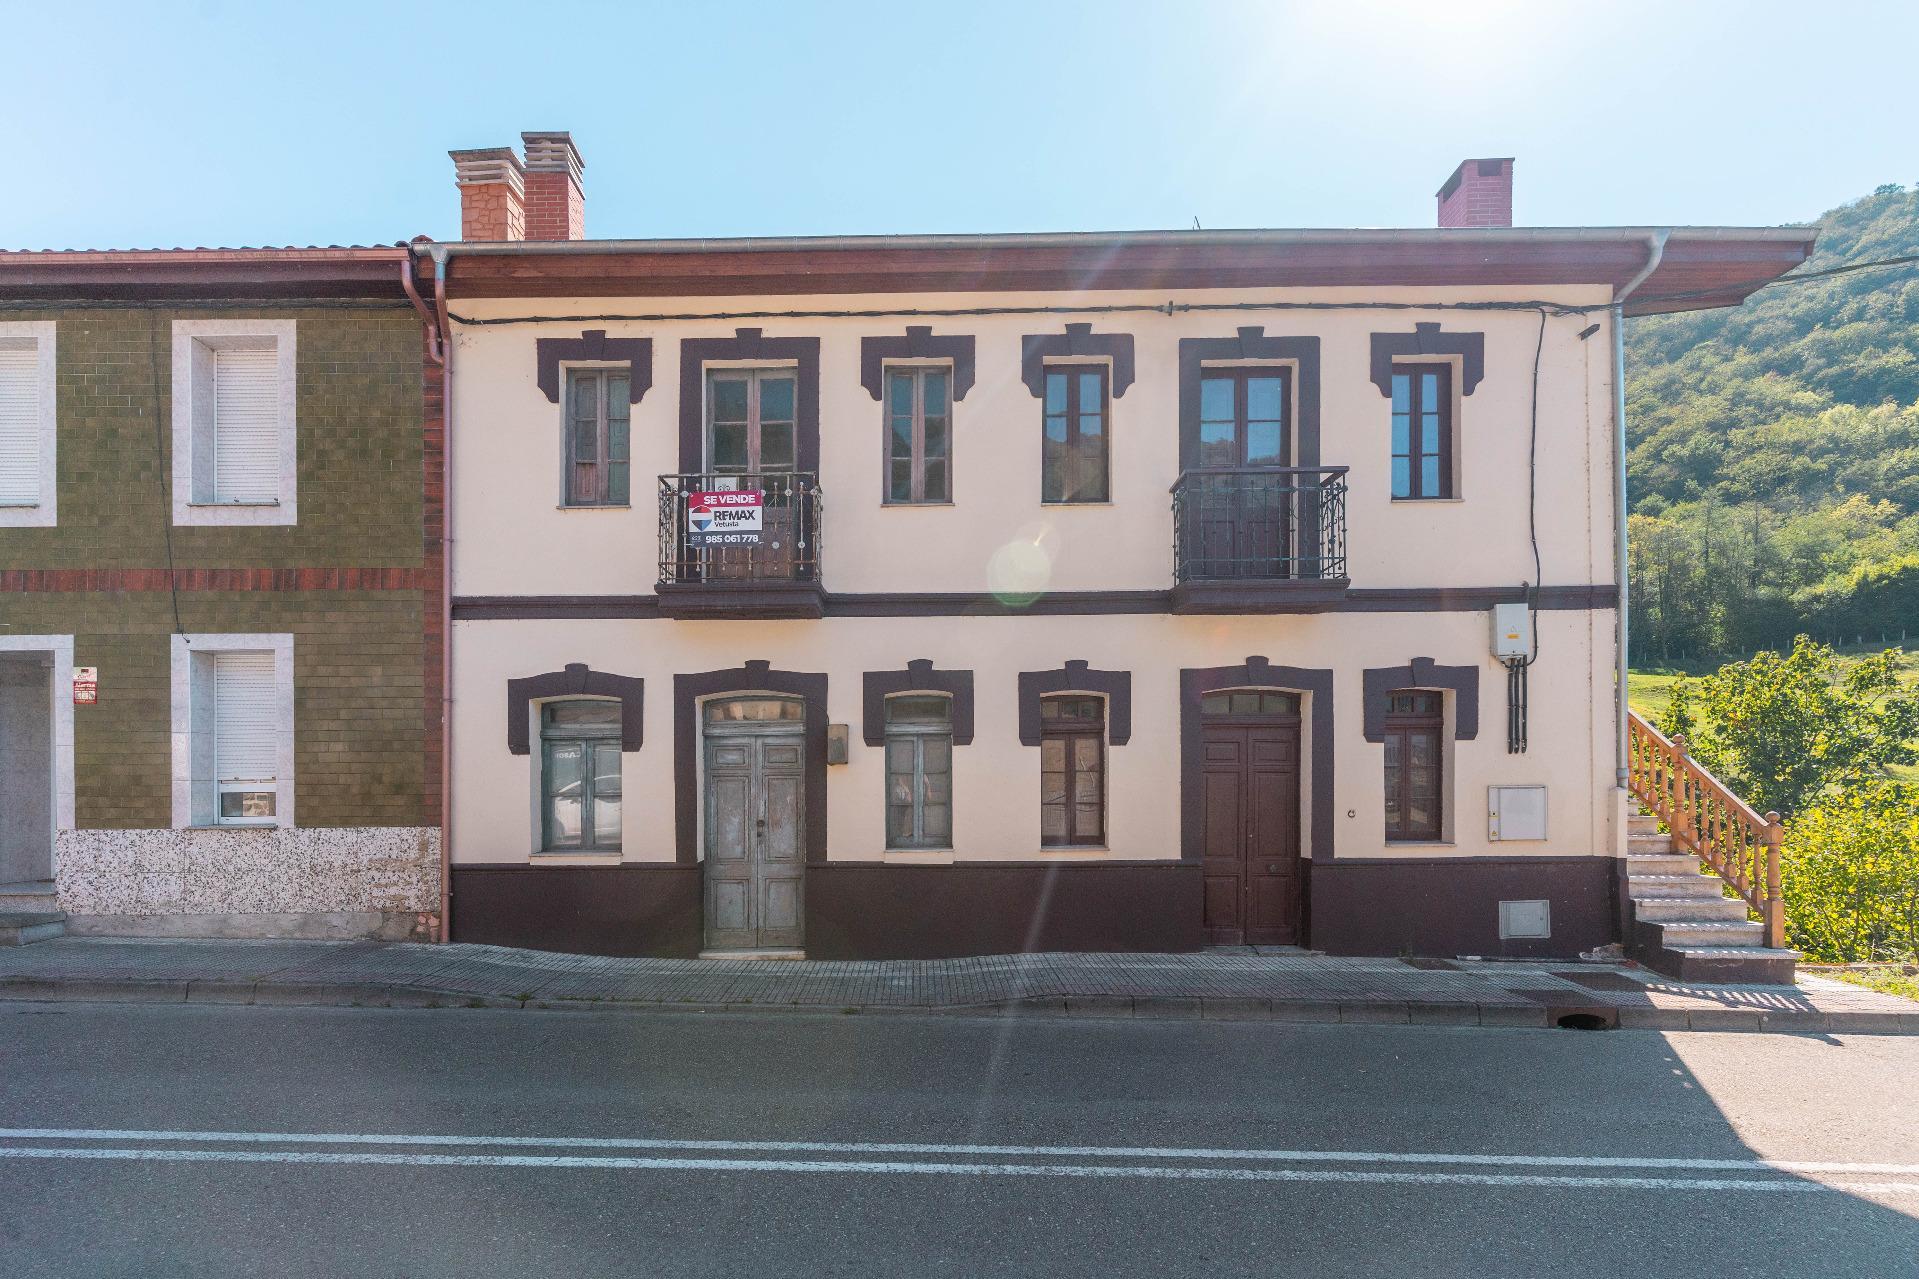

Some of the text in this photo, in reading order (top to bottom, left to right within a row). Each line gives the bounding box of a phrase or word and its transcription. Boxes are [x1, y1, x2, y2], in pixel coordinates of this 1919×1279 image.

[703, 494, 755, 505] SE VENDE
[705, 535, 722, 543] 985
[724, 535, 740, 543] 061
[741, 534, 759, 542] 778
